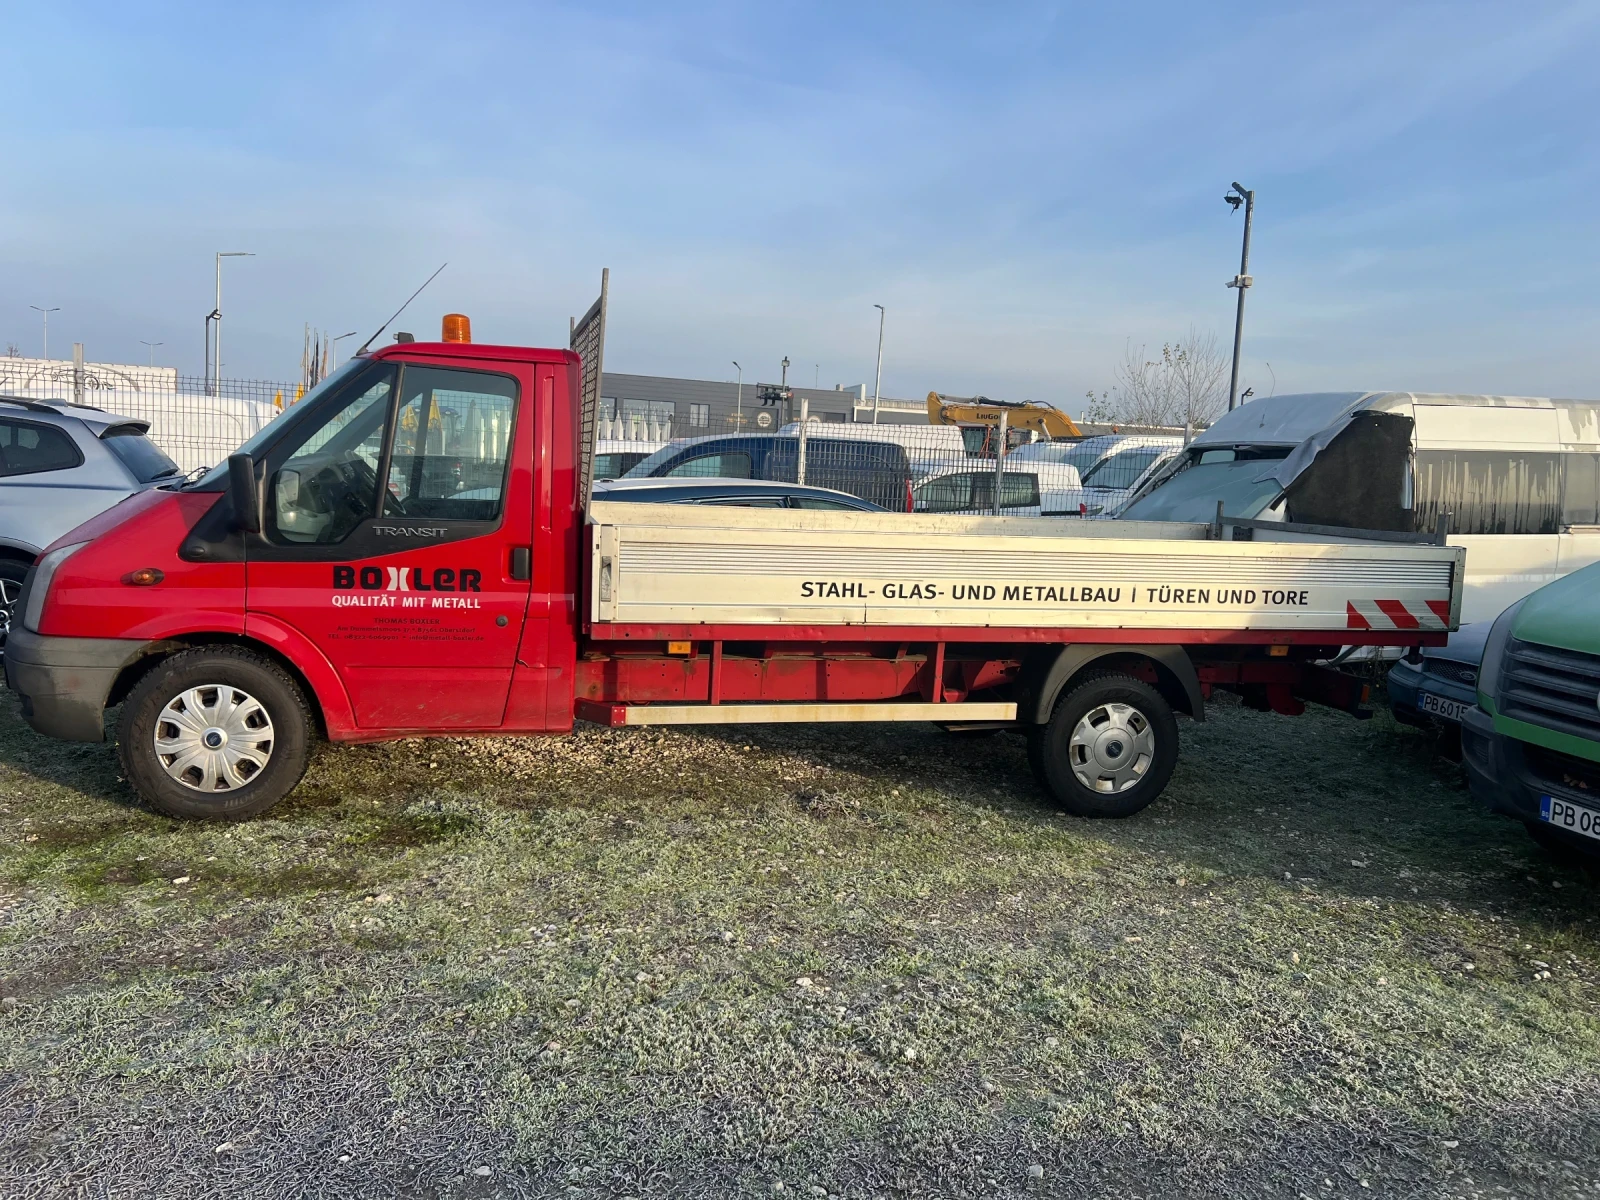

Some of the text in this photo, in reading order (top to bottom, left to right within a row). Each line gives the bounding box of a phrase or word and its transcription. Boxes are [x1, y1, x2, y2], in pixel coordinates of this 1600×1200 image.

[372, 526, 448, 537] TRANSIT
[332, 594, 481, 609] QUALITÄT MIT METALL
[801, 581, 876, 598] STAHL-
[882, 583, 945, 600] GLAS-
[952, 585, 996, 600] UND
[1002, 586, 1121, 602] METALLBAU
[1147, 585, 1210, 604] TÜREN
[1216, 589, 1256, 604] UND
[1261, 590, 1309, 605] TORE
[1552, 802, 1575, 826] PB
